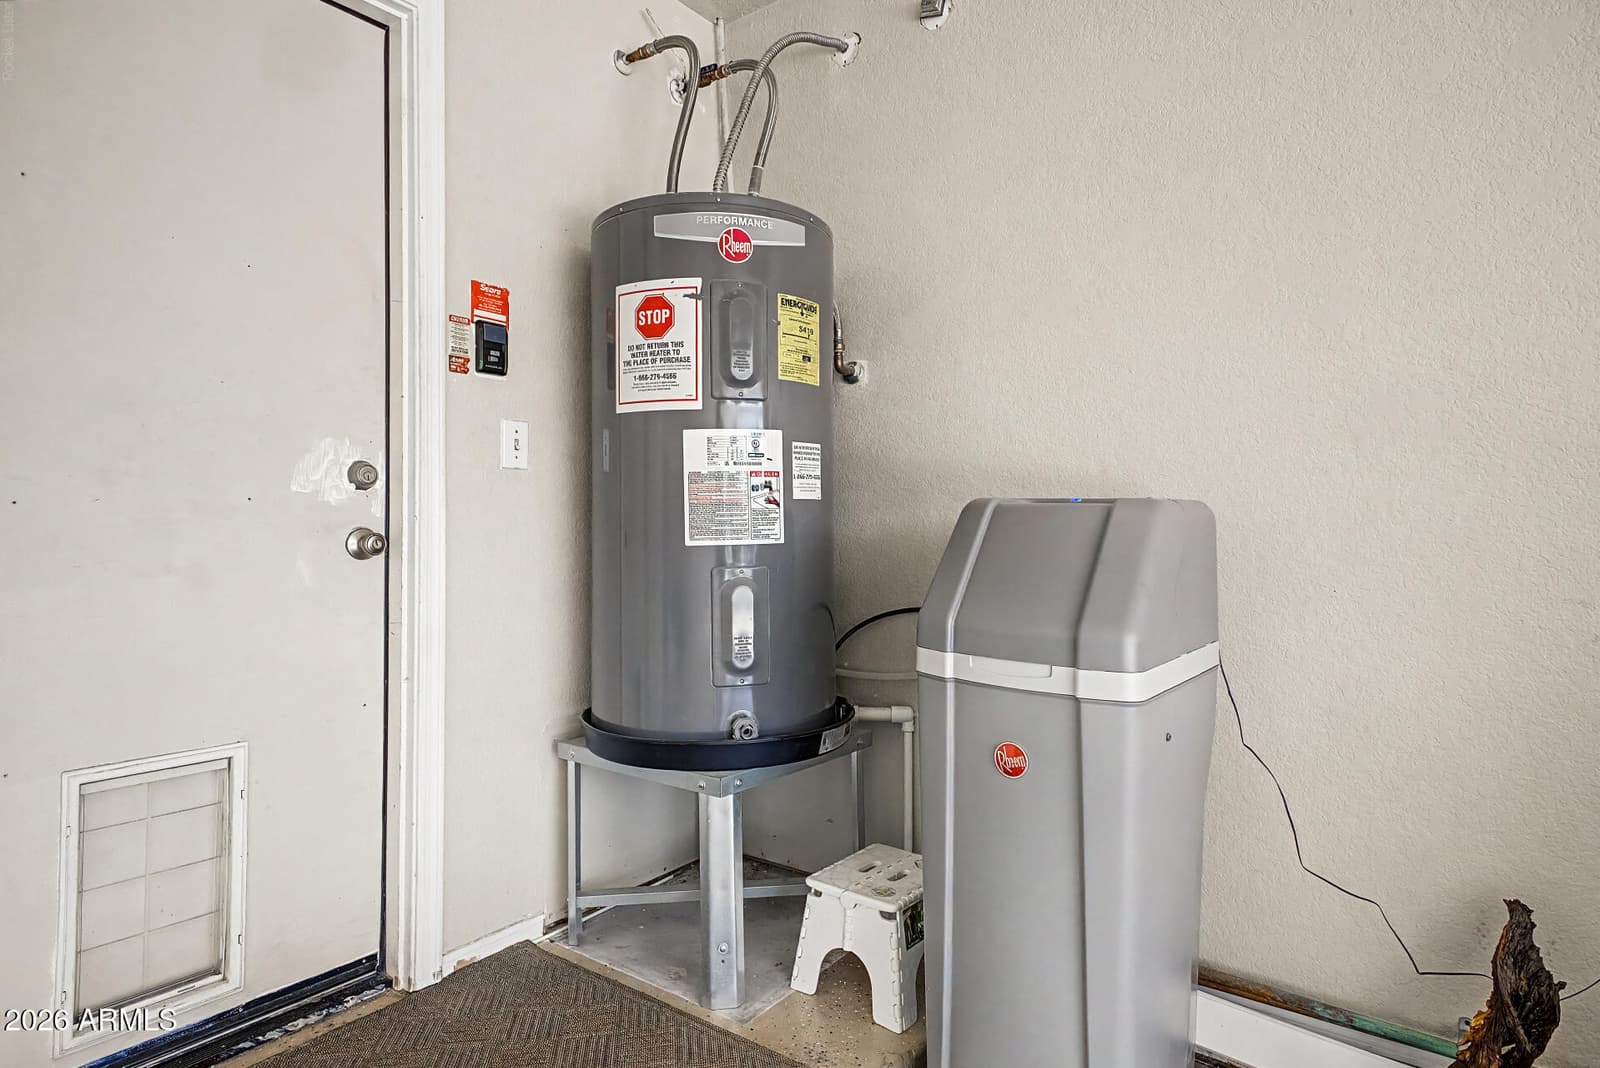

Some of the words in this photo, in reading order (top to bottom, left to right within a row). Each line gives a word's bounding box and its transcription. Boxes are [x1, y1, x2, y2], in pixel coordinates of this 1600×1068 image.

[696, 215, 775, 230] PERFORMANCE
[722, 228, 752, 257] Rheem
[638, 308, 670, 326] STOP
[627, 344, 635, 352] DO
[635, 343, 646, 351] NOT
[646, 342, 669, 350] RETURN
[670, 340, 684, 348] THIS
[630, 351, 648, 359] WATER
[649, 350, 671, 358] HEATER
[632, 358, 649, 366] PLACE
[659, 355, 691, 364] PURCHASE
[997, 745, 1026, 773] Rheem
